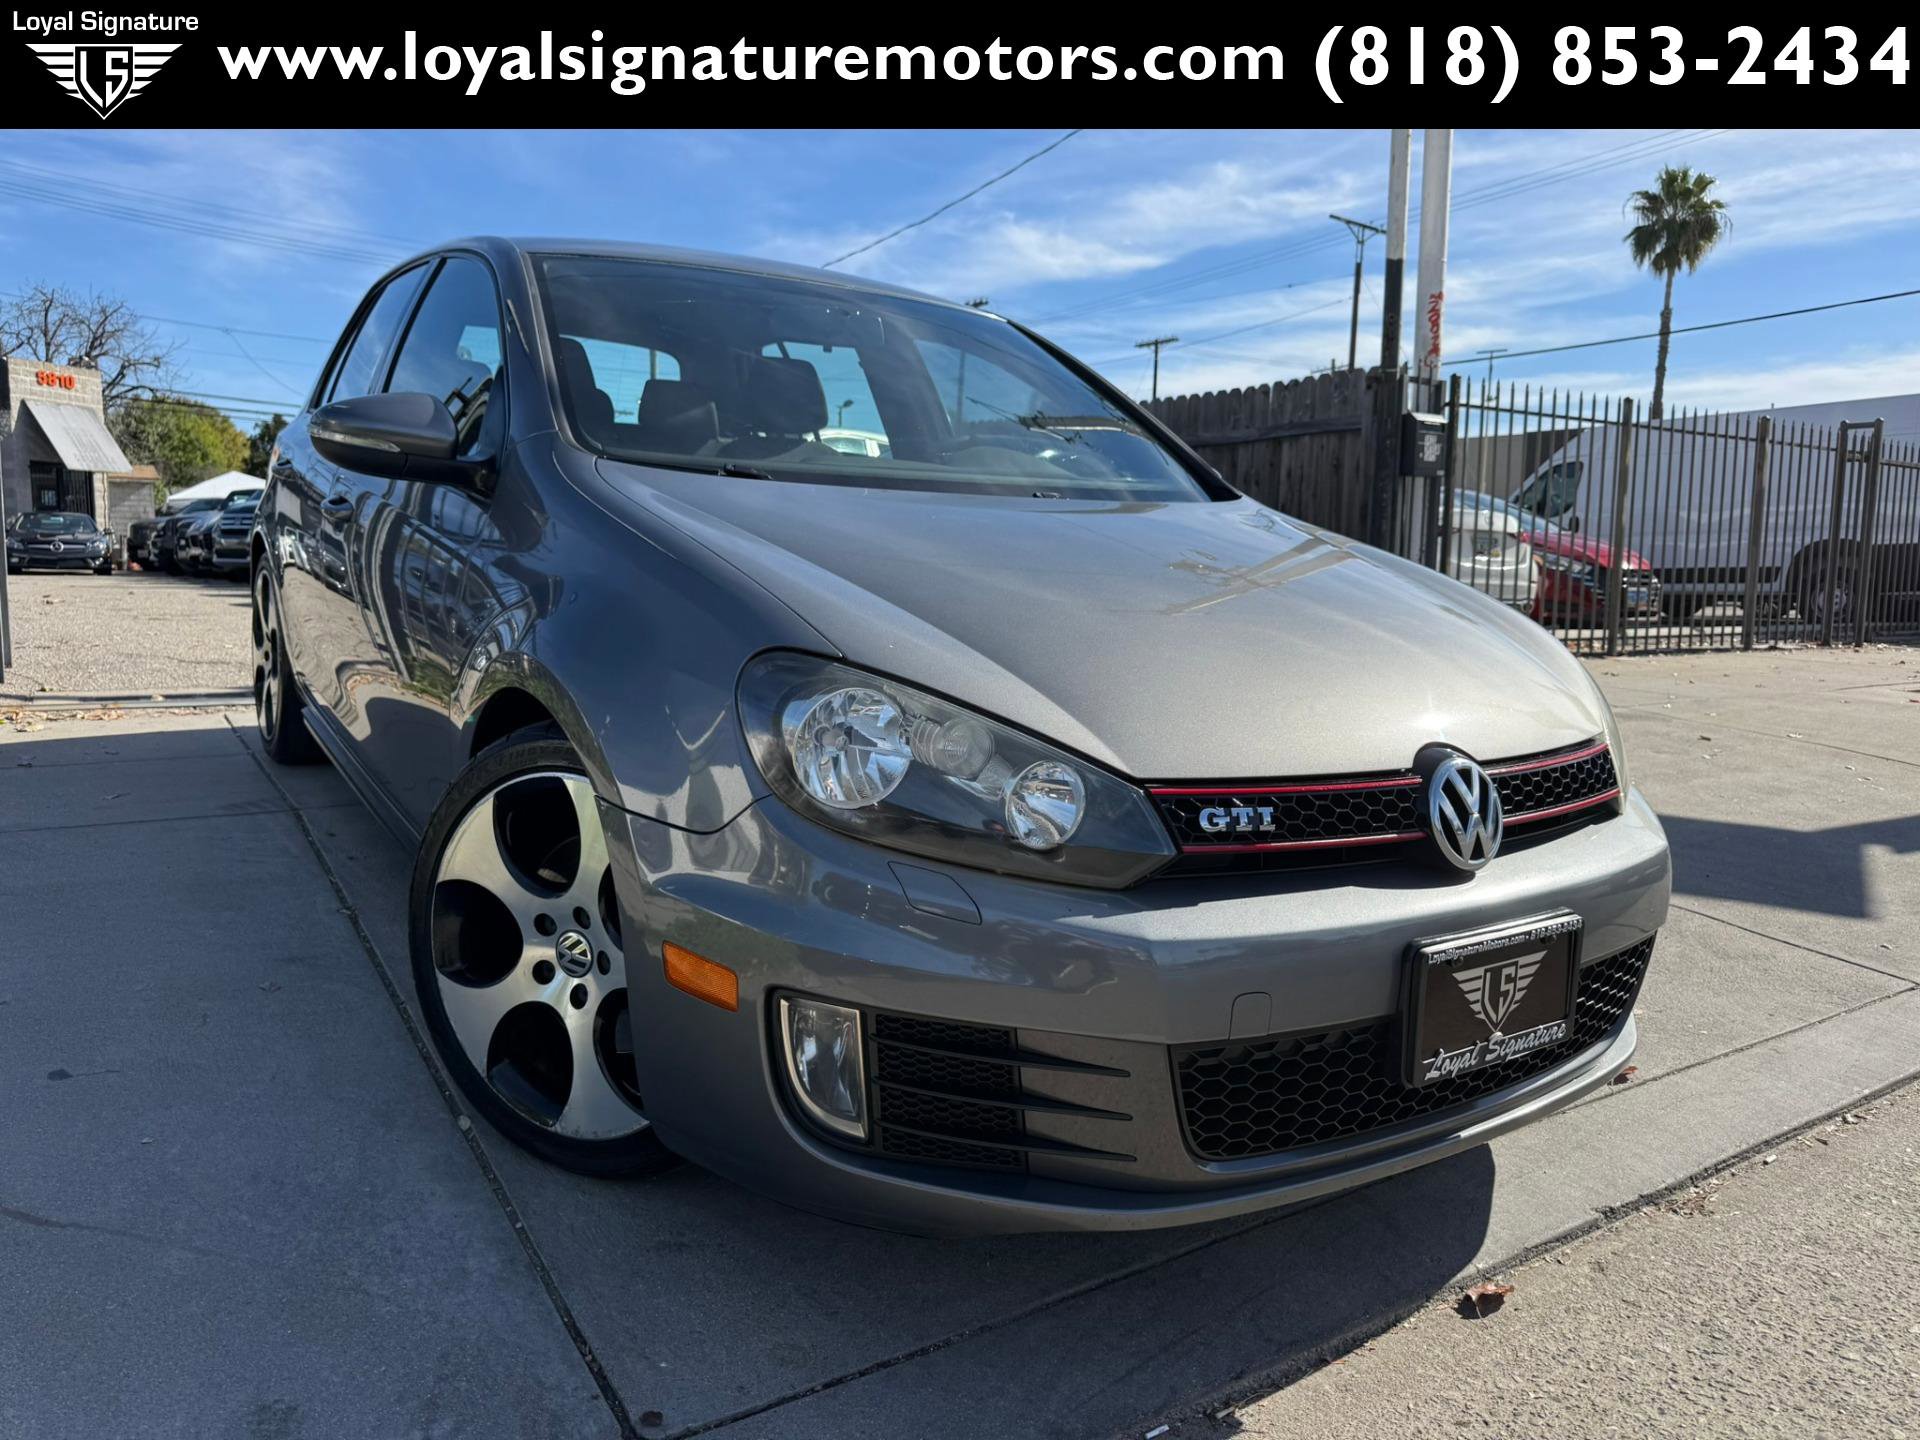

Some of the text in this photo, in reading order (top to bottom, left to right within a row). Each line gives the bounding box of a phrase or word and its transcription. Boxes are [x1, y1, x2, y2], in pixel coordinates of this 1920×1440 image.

[1198, 806, 1276, 832] GTI
[1424, 1023, 1567, 1081] Loyal Signature
